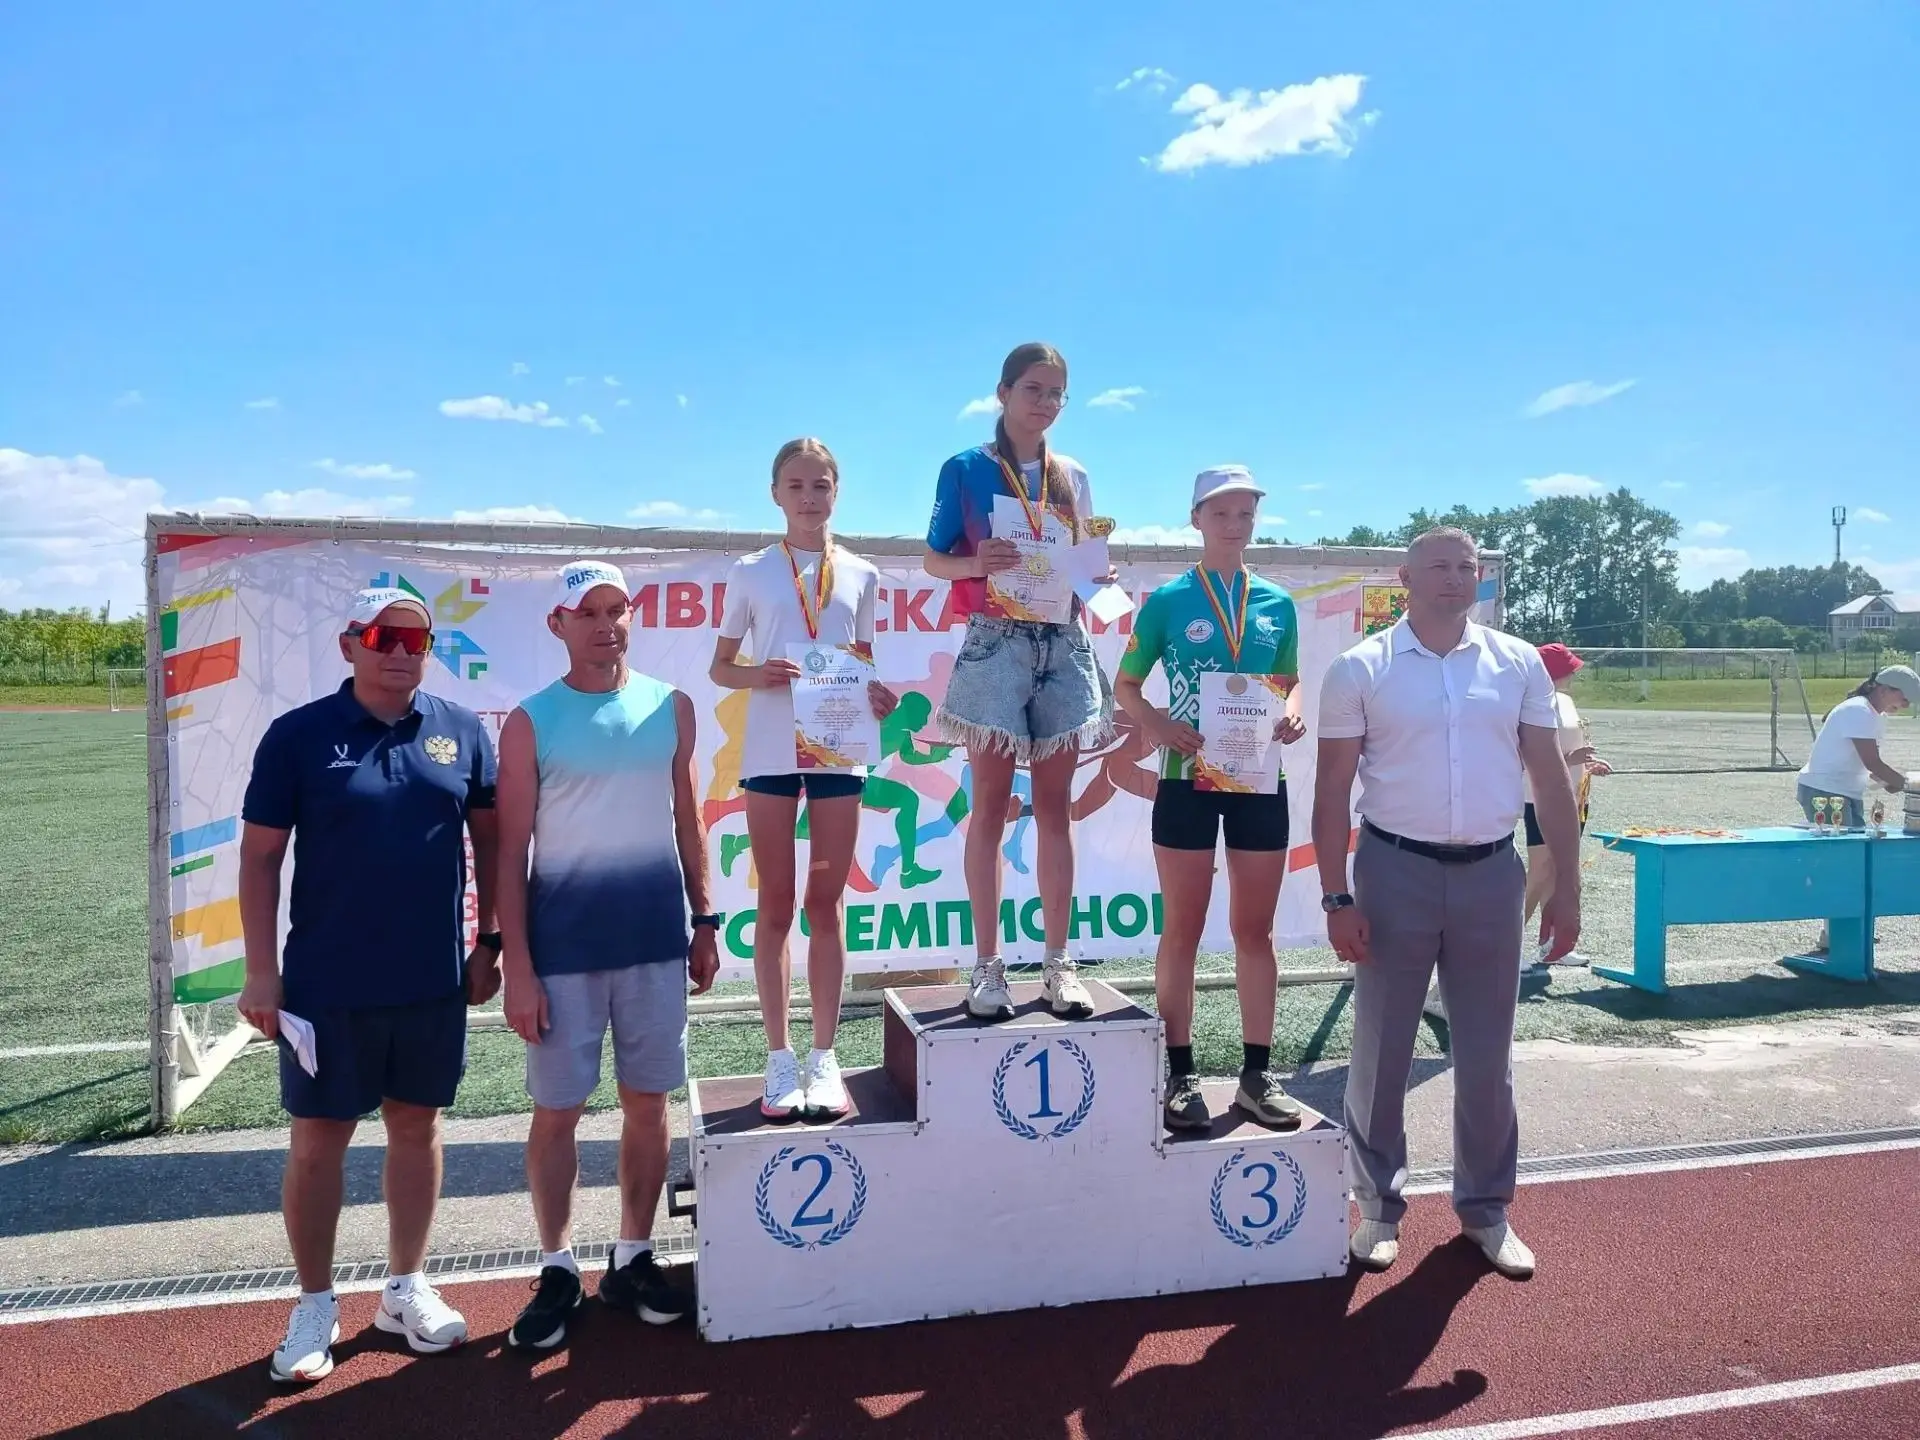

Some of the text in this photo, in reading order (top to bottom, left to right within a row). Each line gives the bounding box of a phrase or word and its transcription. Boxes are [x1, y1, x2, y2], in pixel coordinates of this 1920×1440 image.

[808, 676, 859, 685] ДИПЛОМ
[1217, 706, 1267, 716] ДИПЛОМ
[1023, 1049, 1063, 1119] 1
[791, 1153, 834, 1228] 2
[1241, 1162, 1279, 1229] 3
